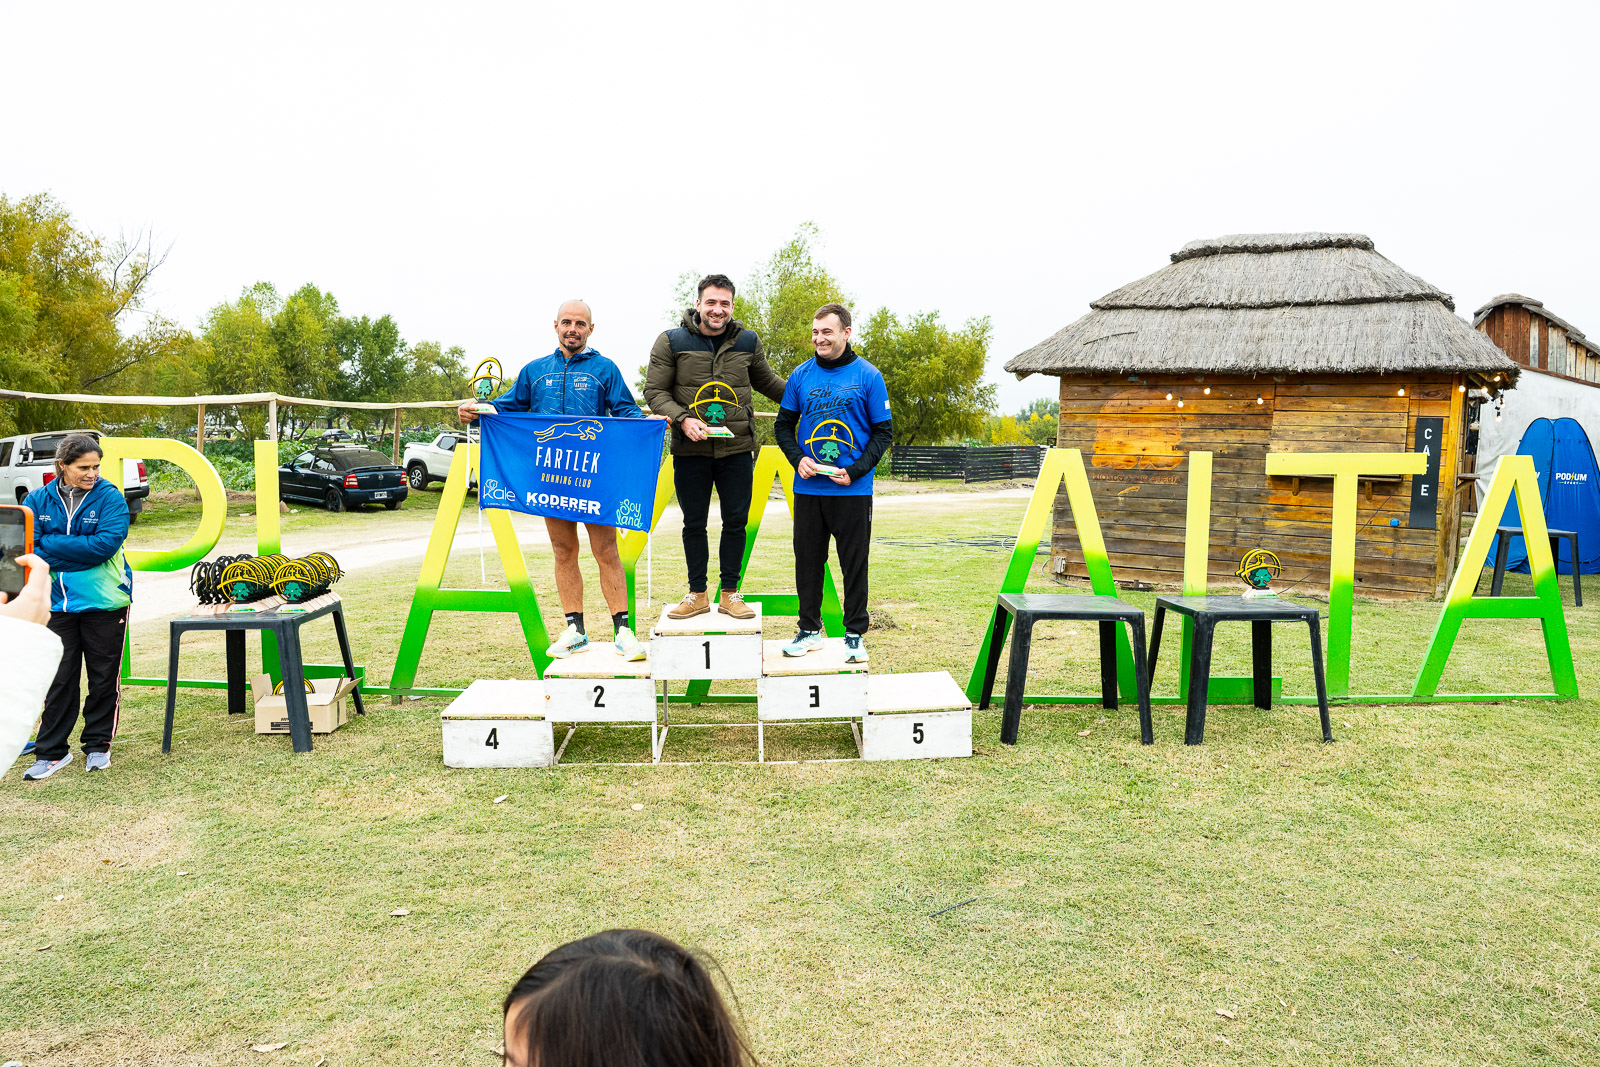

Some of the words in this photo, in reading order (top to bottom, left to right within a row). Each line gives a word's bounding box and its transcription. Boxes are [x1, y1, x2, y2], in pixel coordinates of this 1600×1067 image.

[806, 388, 832, 401] Sin
[535, 446, 601, 474] FARTLEK
[1420, 428, 1433, 496] CAE
[541, 473, 572, 486] RUNNING
[574, 476, 592, 489] CLUB
[526, 492, 601, 515] KODERER
[621, 498, 642, 516] Soy
[965, 449, 1579, 699] ALTA
[702, 640, 711, 670] 1
[592, 684, 606, 708] 2
[808, 685, 820, 708] 3
[485, 727, 500, 750] 4
[912, 722, 925, 745] 5
